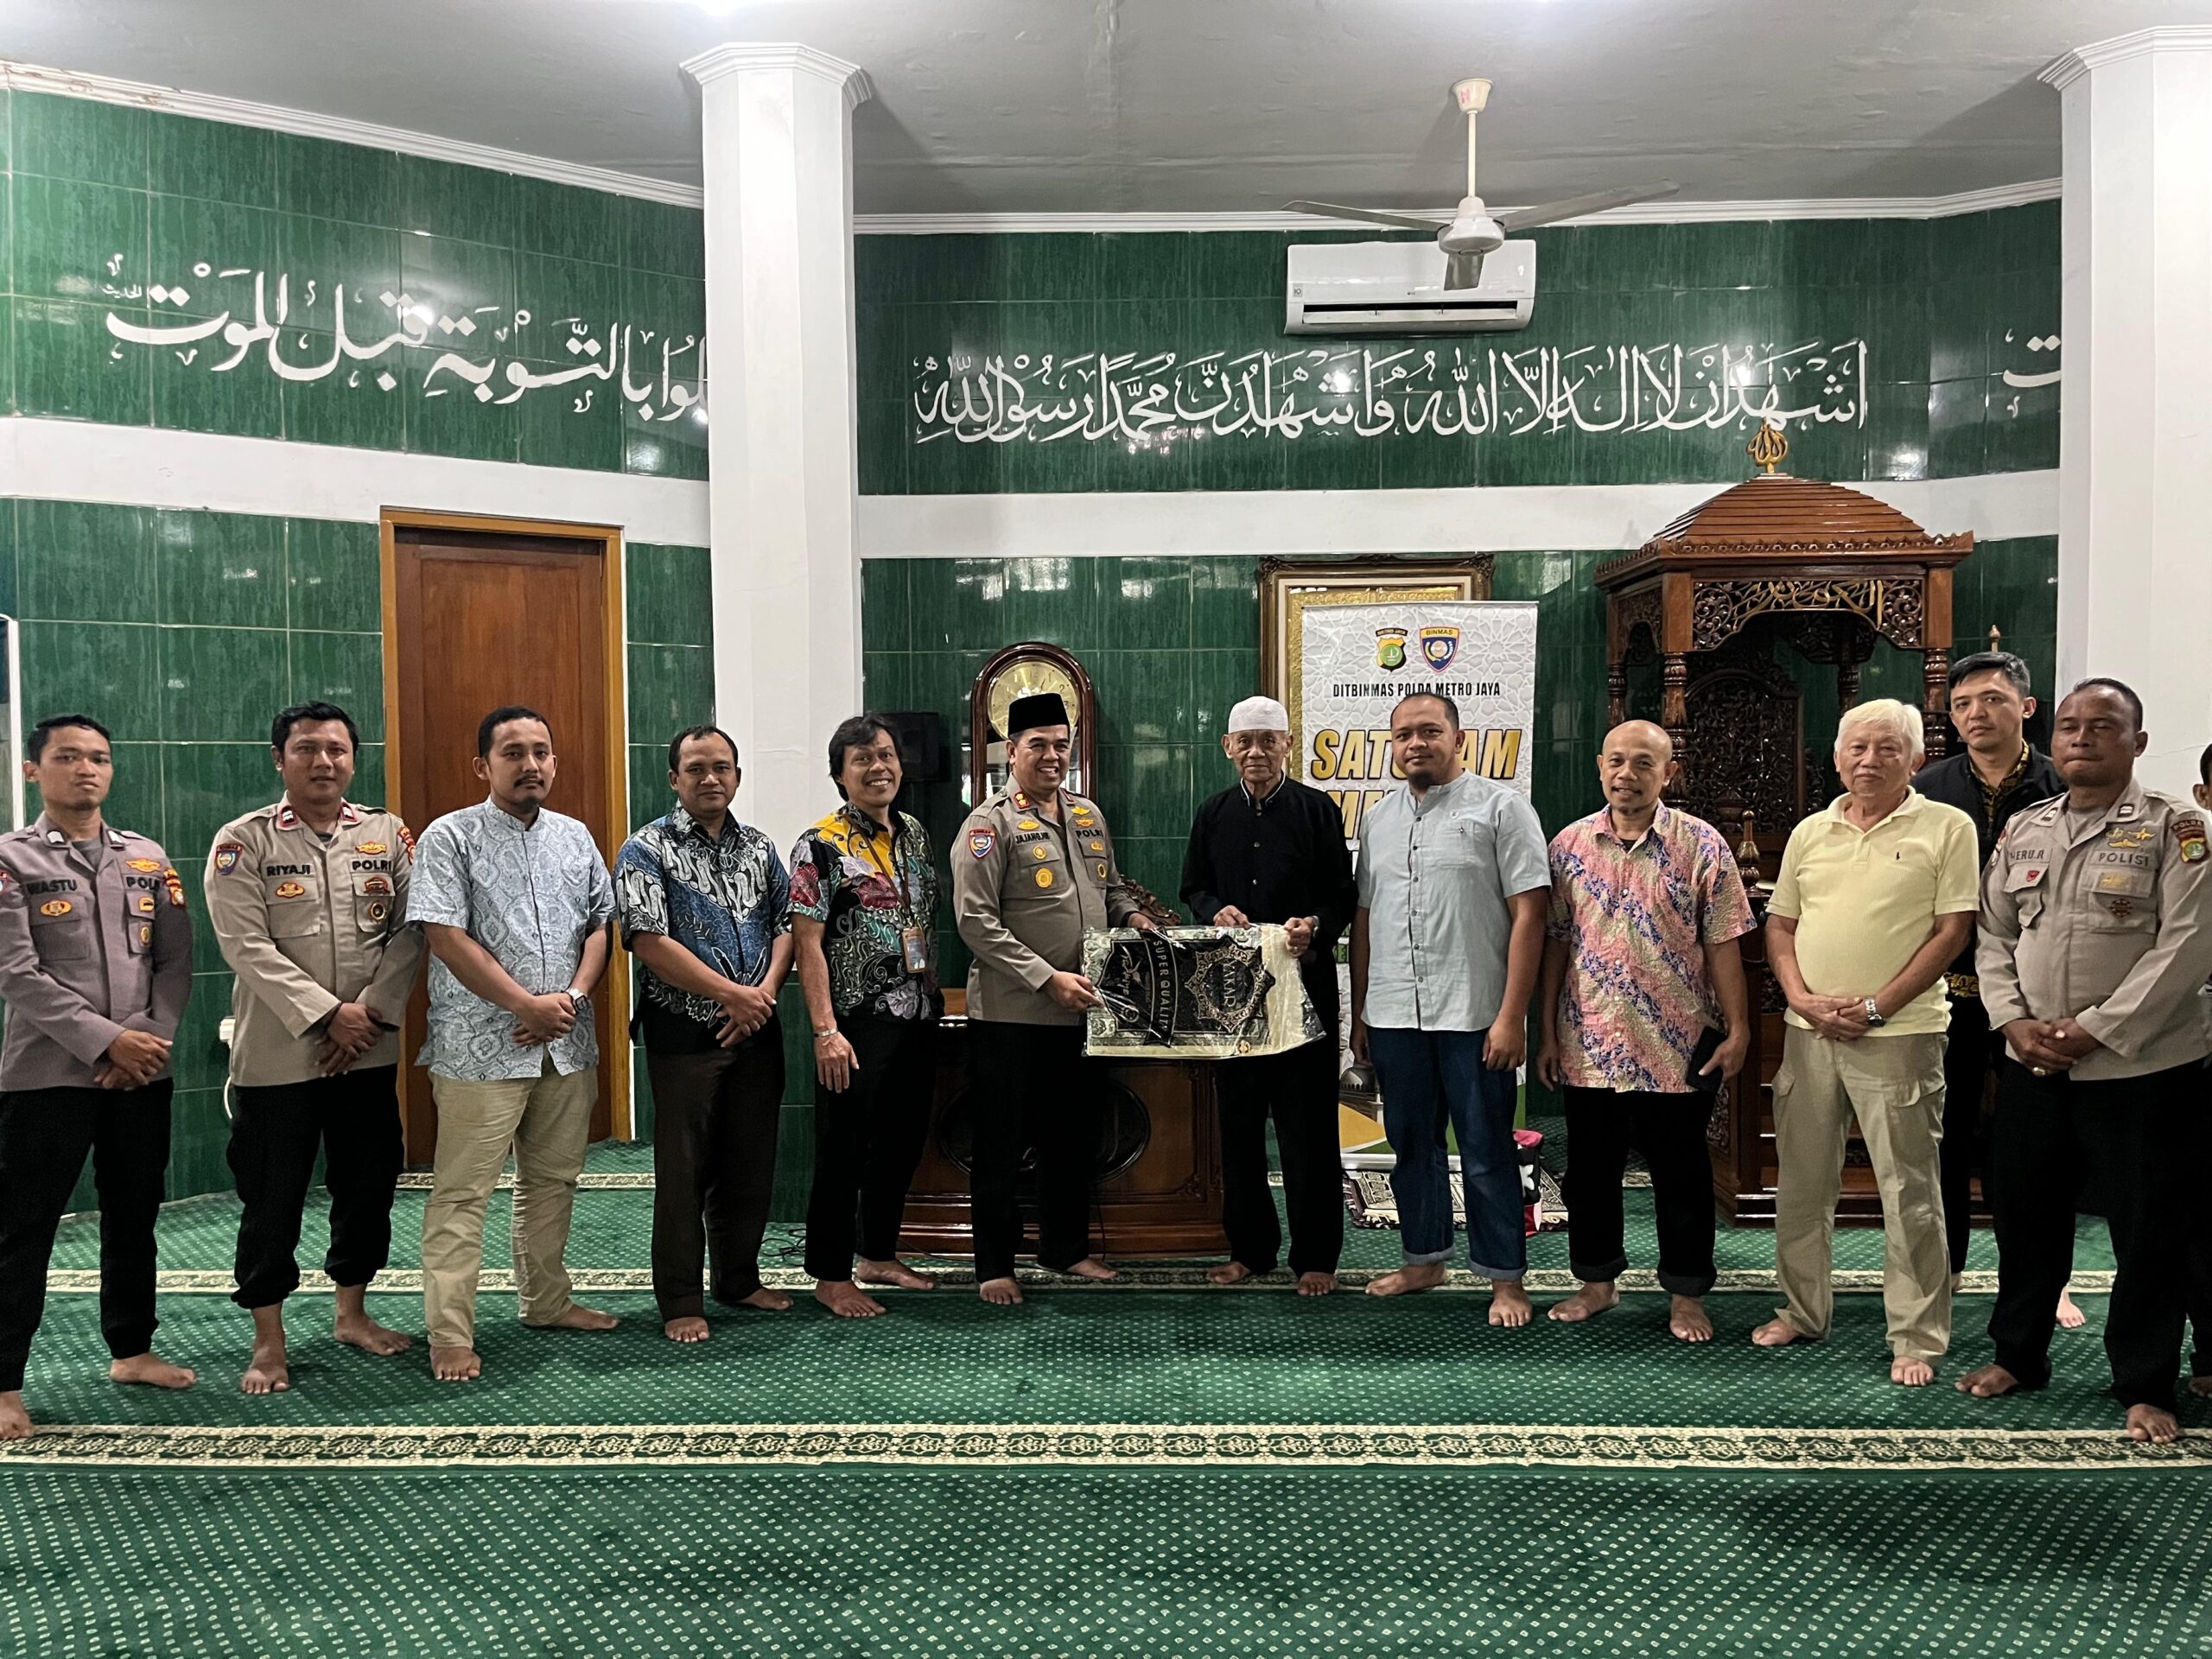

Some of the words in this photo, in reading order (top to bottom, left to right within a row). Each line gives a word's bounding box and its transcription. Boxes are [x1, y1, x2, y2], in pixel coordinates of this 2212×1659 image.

[1333, 683, 1394, 697] DITBINMAS
[1435, 682, 1472, 696] METRO
[1476, 682, 1500, 696] JAYA
[2099, 852, 2149, 865] POLISI
[266, 865, 311, 877] RIYAJI
[352, 860, 392, 872] POLRI
[27, 880, 78, 895] WASTU
[1153, 940, 1169, 976] SUPER
